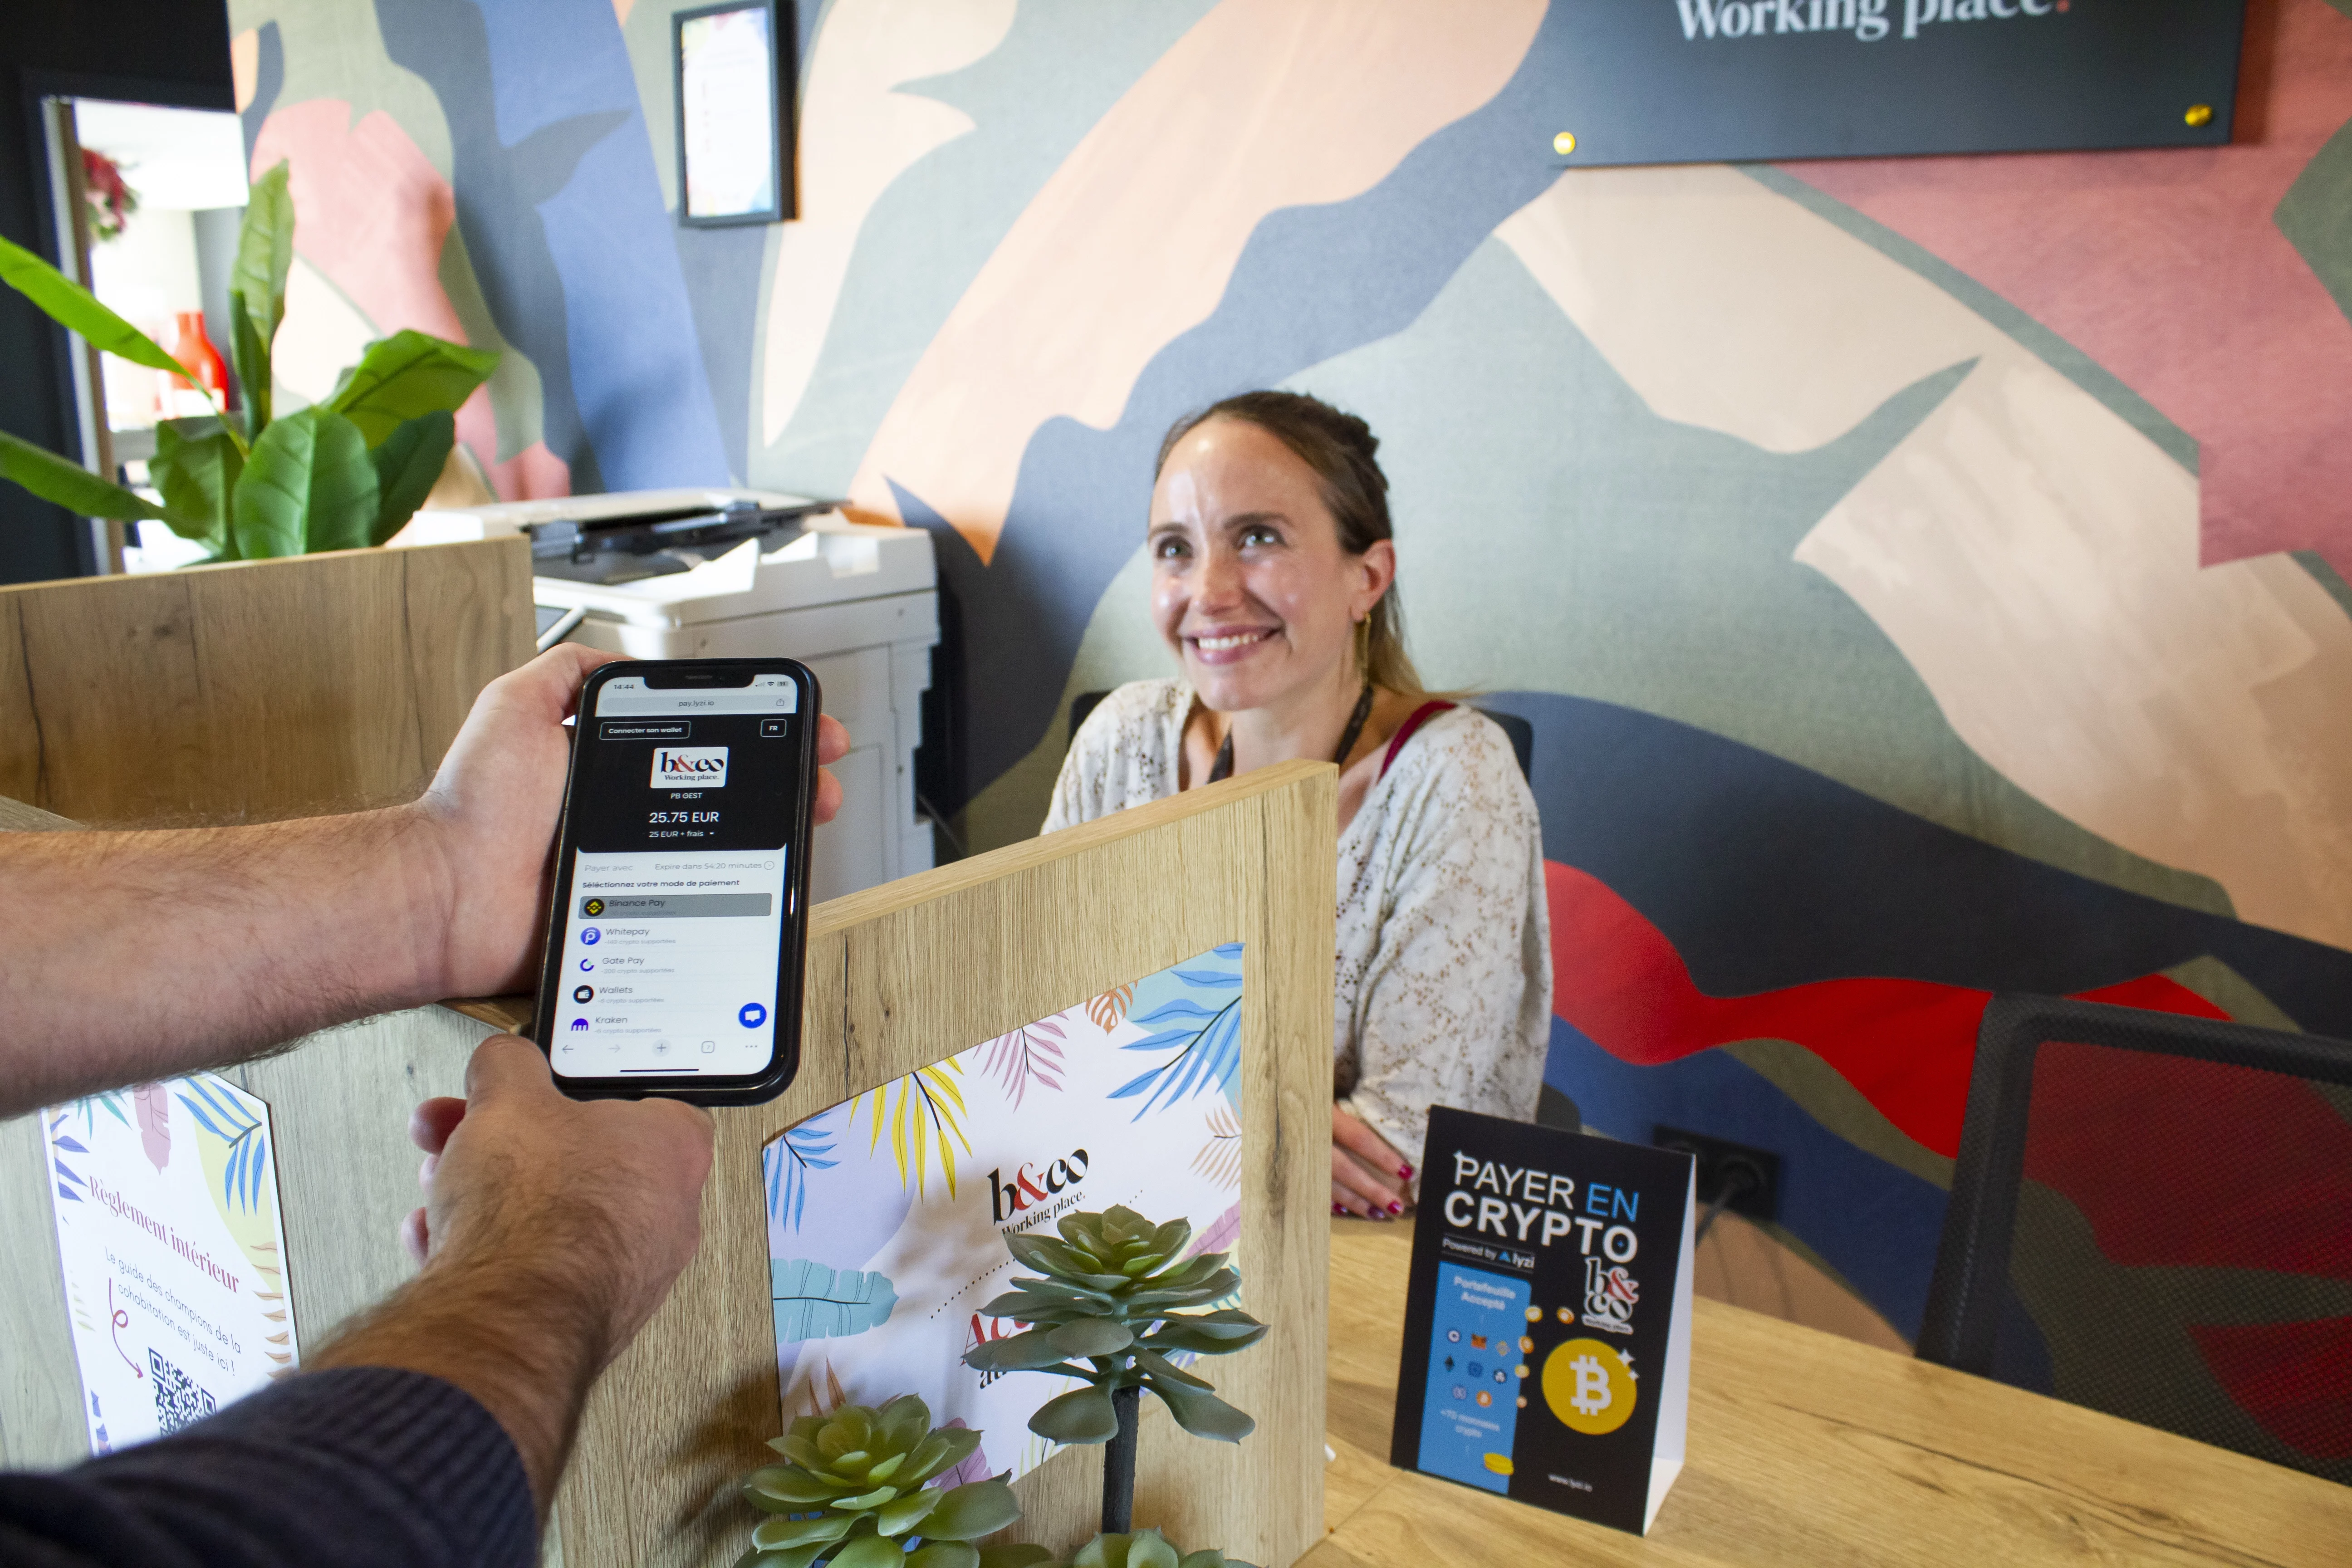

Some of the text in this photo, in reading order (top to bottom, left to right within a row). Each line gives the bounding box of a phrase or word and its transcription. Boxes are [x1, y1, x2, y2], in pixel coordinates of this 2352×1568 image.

[1678, 0, 1890, 42] Working
[661, 751, 724, 773] b&co
[648, 812, 720, 823] 25.75 EUR
[628, 957, 645, 965] Pay
[987, 1148, 1088, 1226] b&co
[1054, 1191, 1086, 1218] place.
[1453, 1152, 1639, 1223] PAYER EN
[89, 1175, 239, 1294] Règlement intérieur
[1442, 1237, 1535, 1269] Powered by lyzi
[1444, 1190, 1638, 1263] CRYPTO
[105, 1246, 241, 1354] Le guide des champions de la
[118, 1284, 235, 1376] cohabitation est juste ici !
